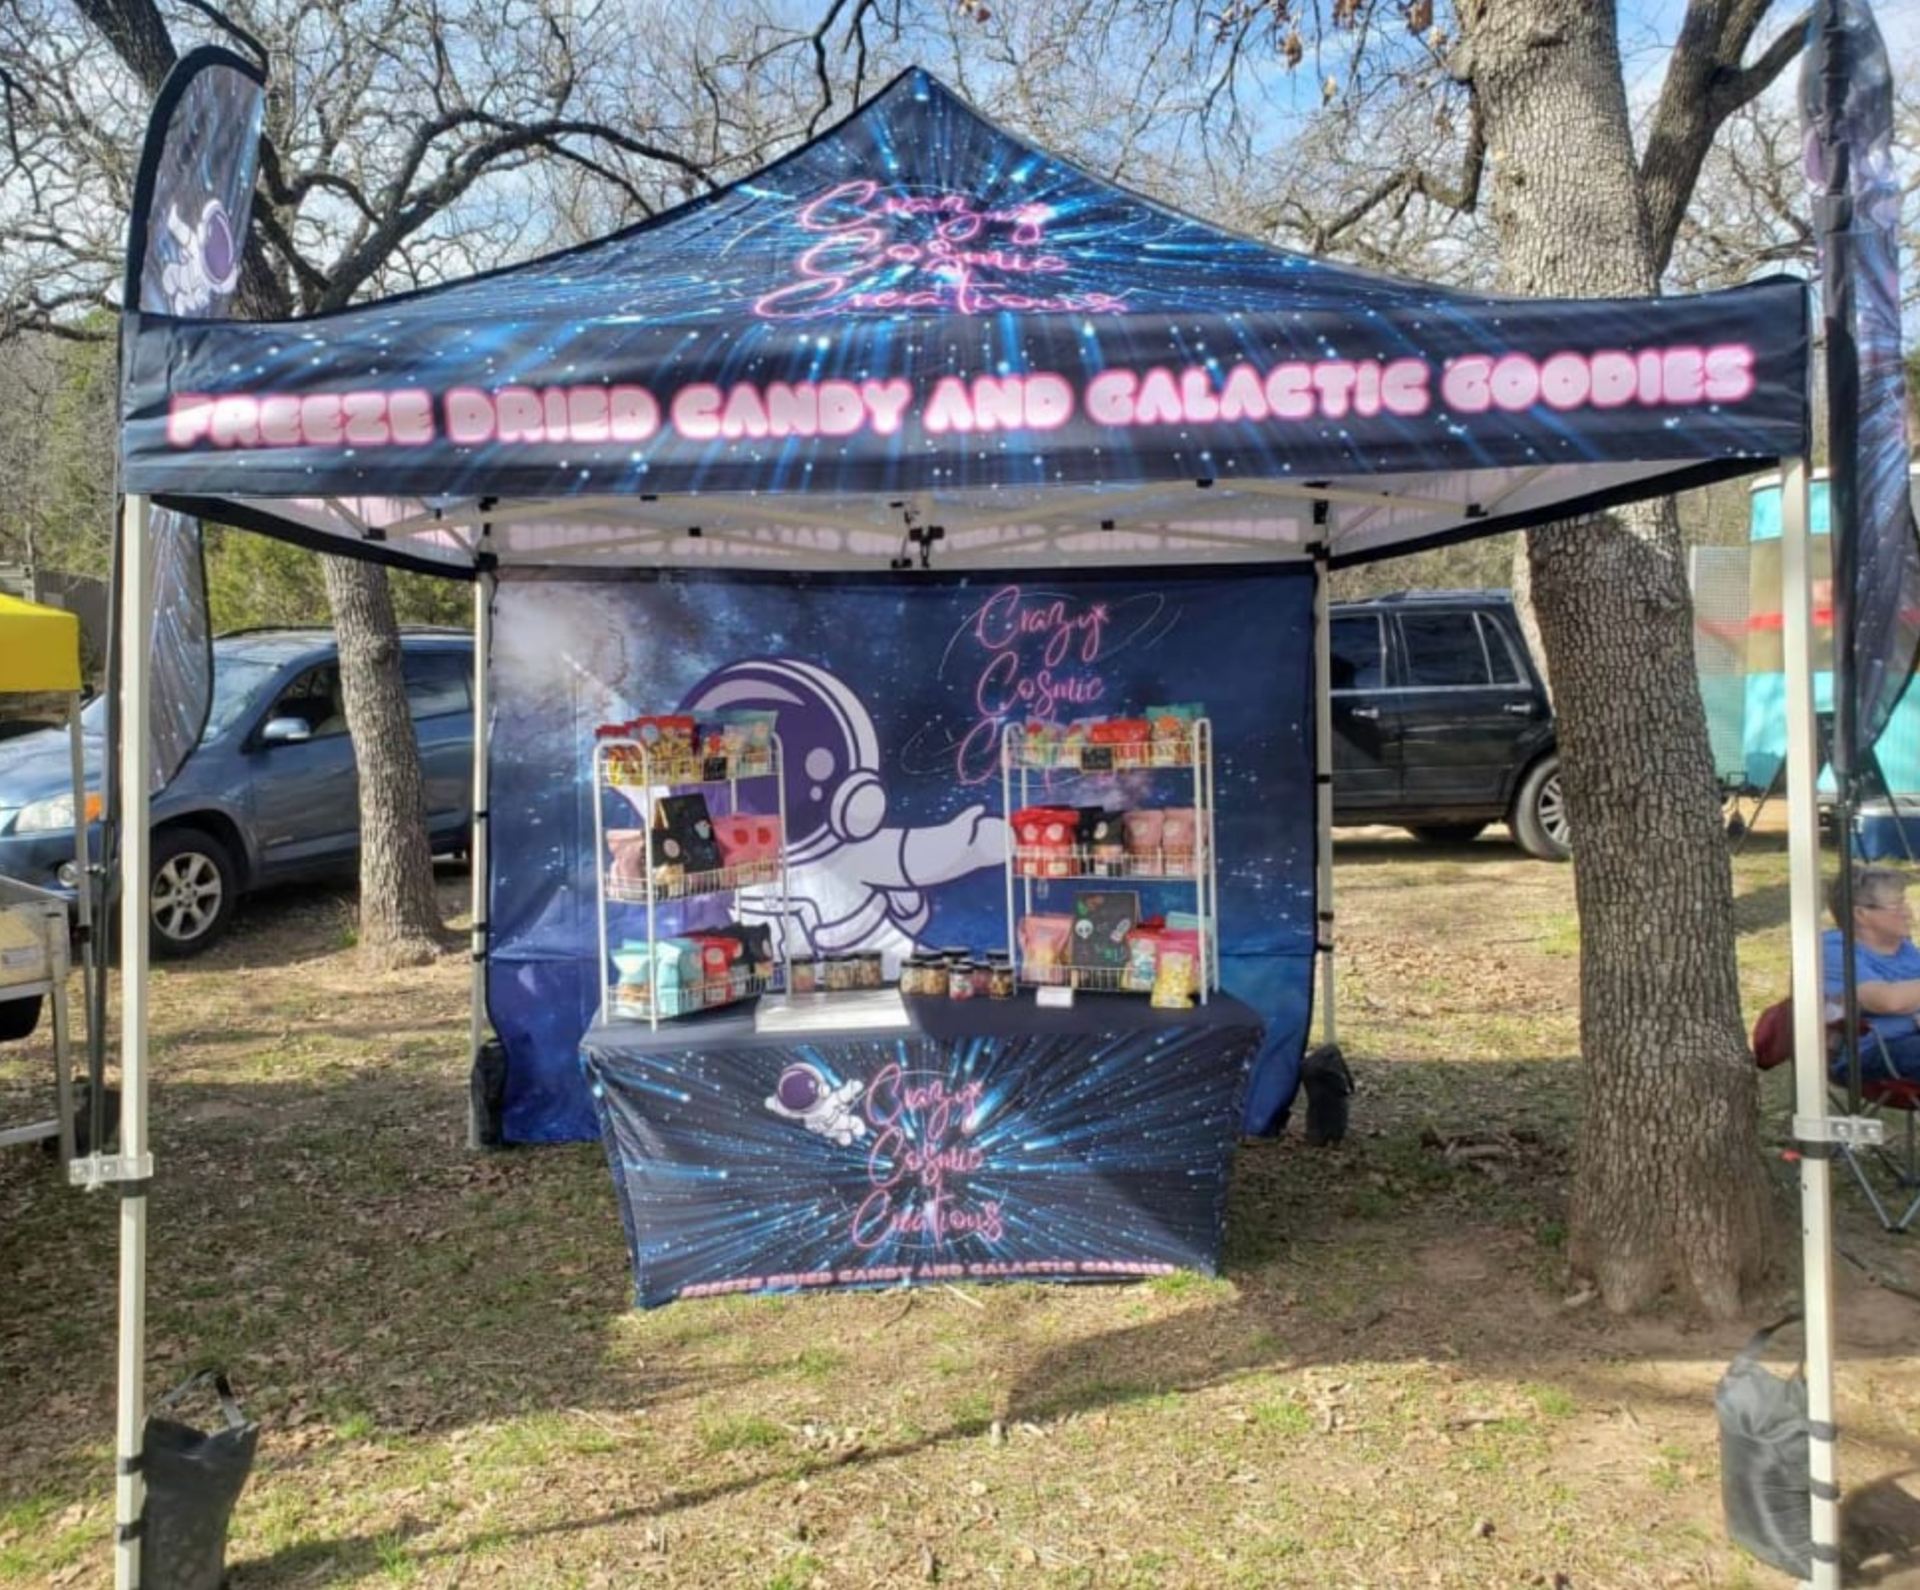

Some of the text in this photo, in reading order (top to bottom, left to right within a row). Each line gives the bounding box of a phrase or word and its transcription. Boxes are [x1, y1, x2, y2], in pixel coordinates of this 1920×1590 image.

[168, 345, 1755, 449] FREEZE DRIED CANDY AND GALACTIC GOODIES
[975, 585, 1107, 667] Crazy
[977, 651, 1105, 717] Cosmic
[866, 1063, 984, 1140] Crazy
[918, 1263, 964, 1277] AND
